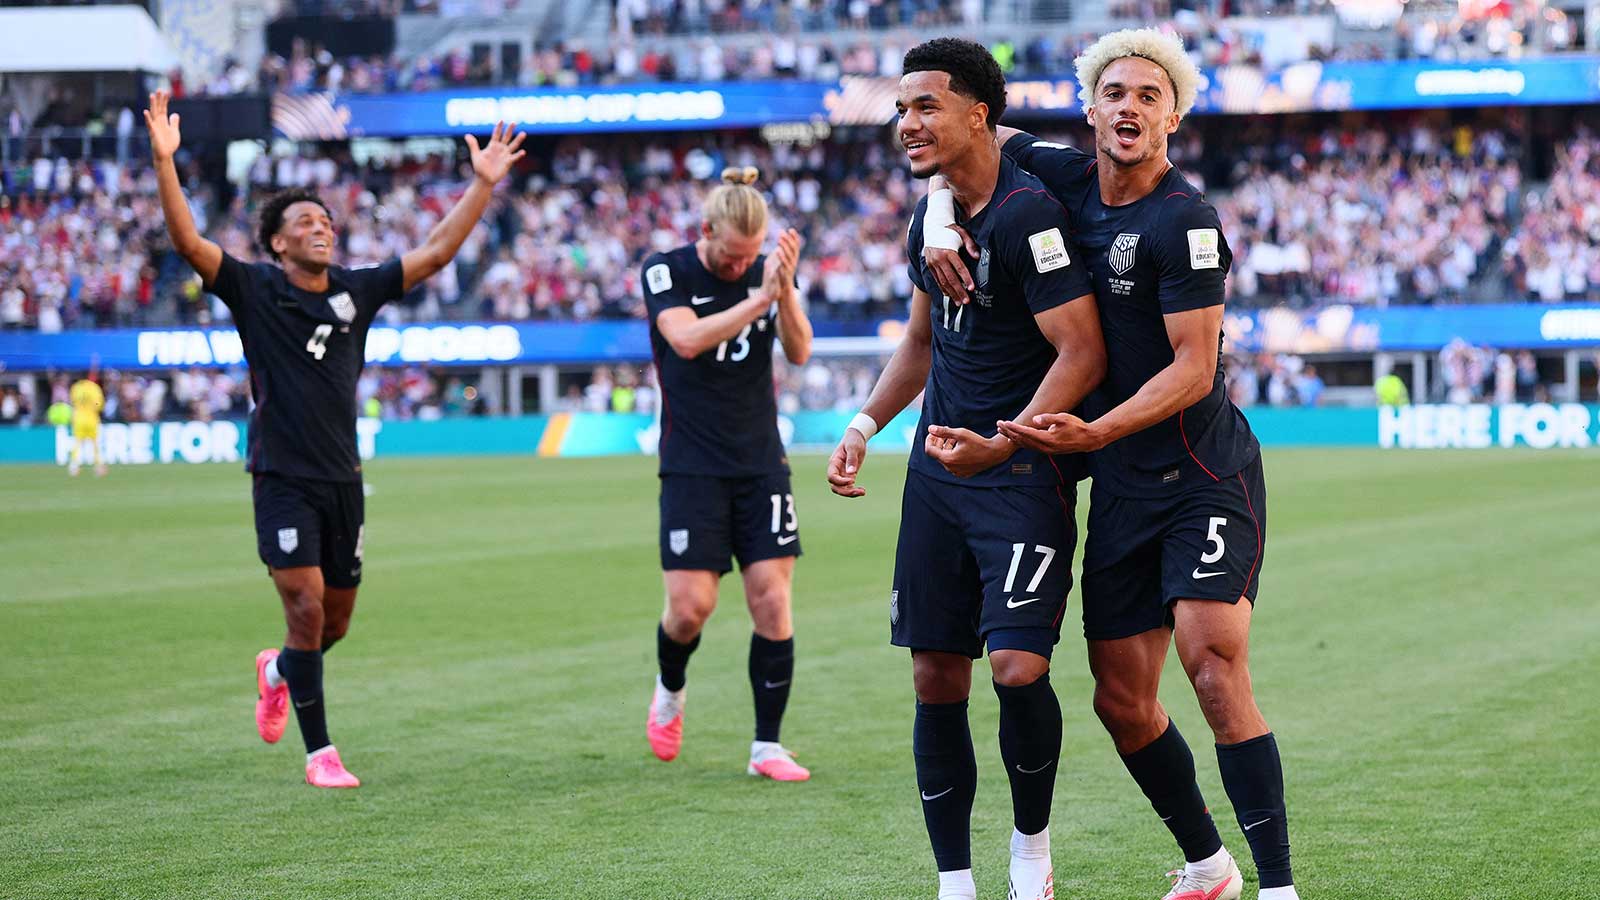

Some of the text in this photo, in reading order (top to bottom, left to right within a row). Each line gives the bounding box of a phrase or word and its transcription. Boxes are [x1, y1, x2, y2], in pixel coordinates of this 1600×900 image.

[1116, 235, 1136, 251] USA
[137, 331, 212, 365] FIFA
[401, 325, 521, 361] 2026
[306, 324, 333, 360] 4
[158, 421, 240, 463] FOR
[1378, 402, 1592, 448] HERE FOR
[771, 494, 798, 533] 13
[1201, 517, 1228, 564] 5
[1003, 543, 1056, 593] 17
